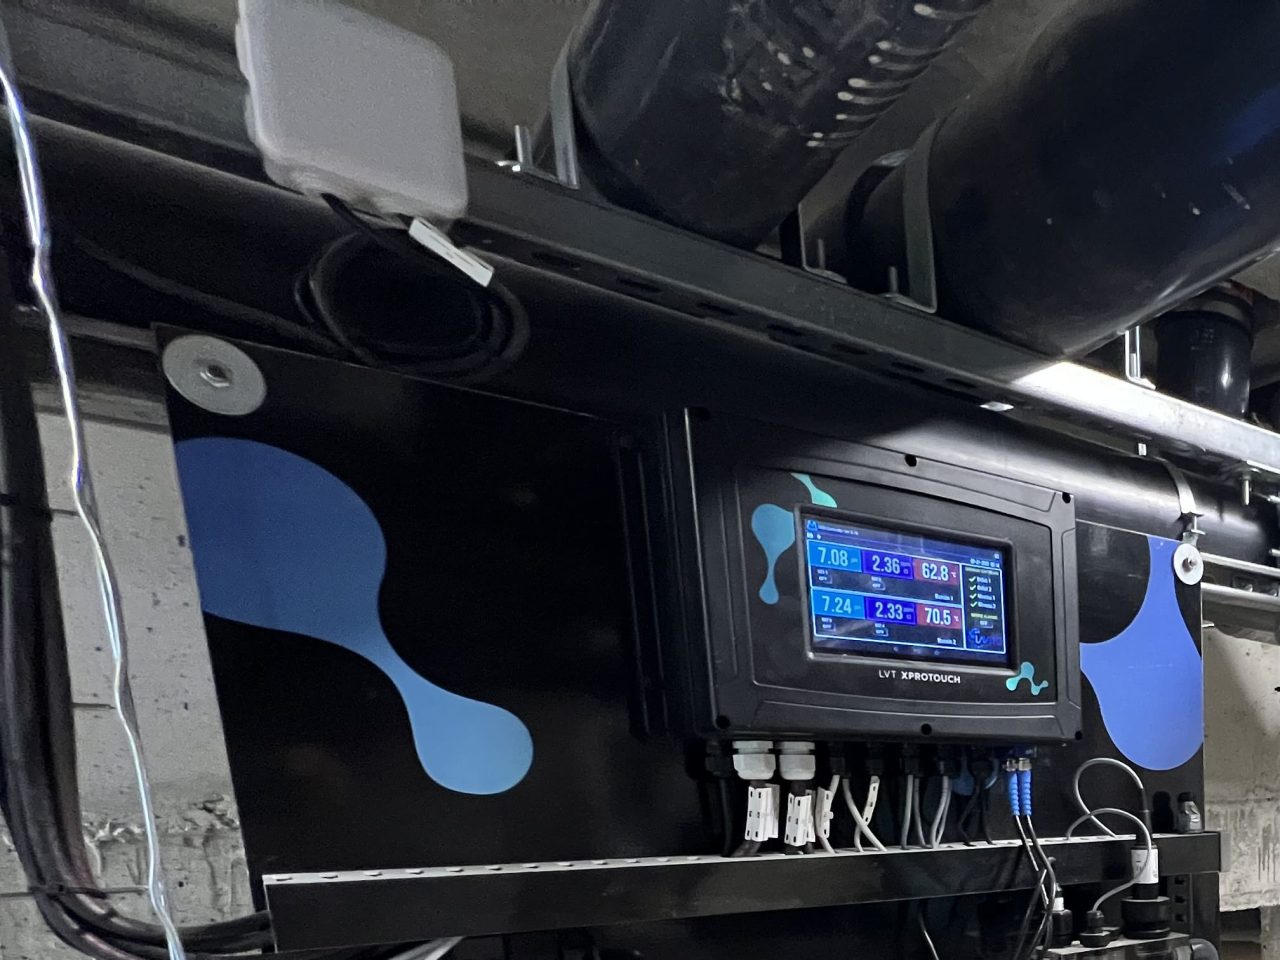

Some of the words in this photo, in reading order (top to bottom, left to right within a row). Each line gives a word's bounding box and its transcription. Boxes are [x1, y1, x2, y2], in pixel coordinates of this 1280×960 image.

[817, 547, 848, 567] 7.08
[872, 555, 901, 574] 2.36
[922, 563, 949, 581] 62.8
[821, 596, 852, 614] 7.24
[875, 602, 903, 620] 2.33
[925, 608, 951, 625] 70.5
[878, 669, 896, 679] LVT
[901, 671, 961, 684] XPROTOUCH
